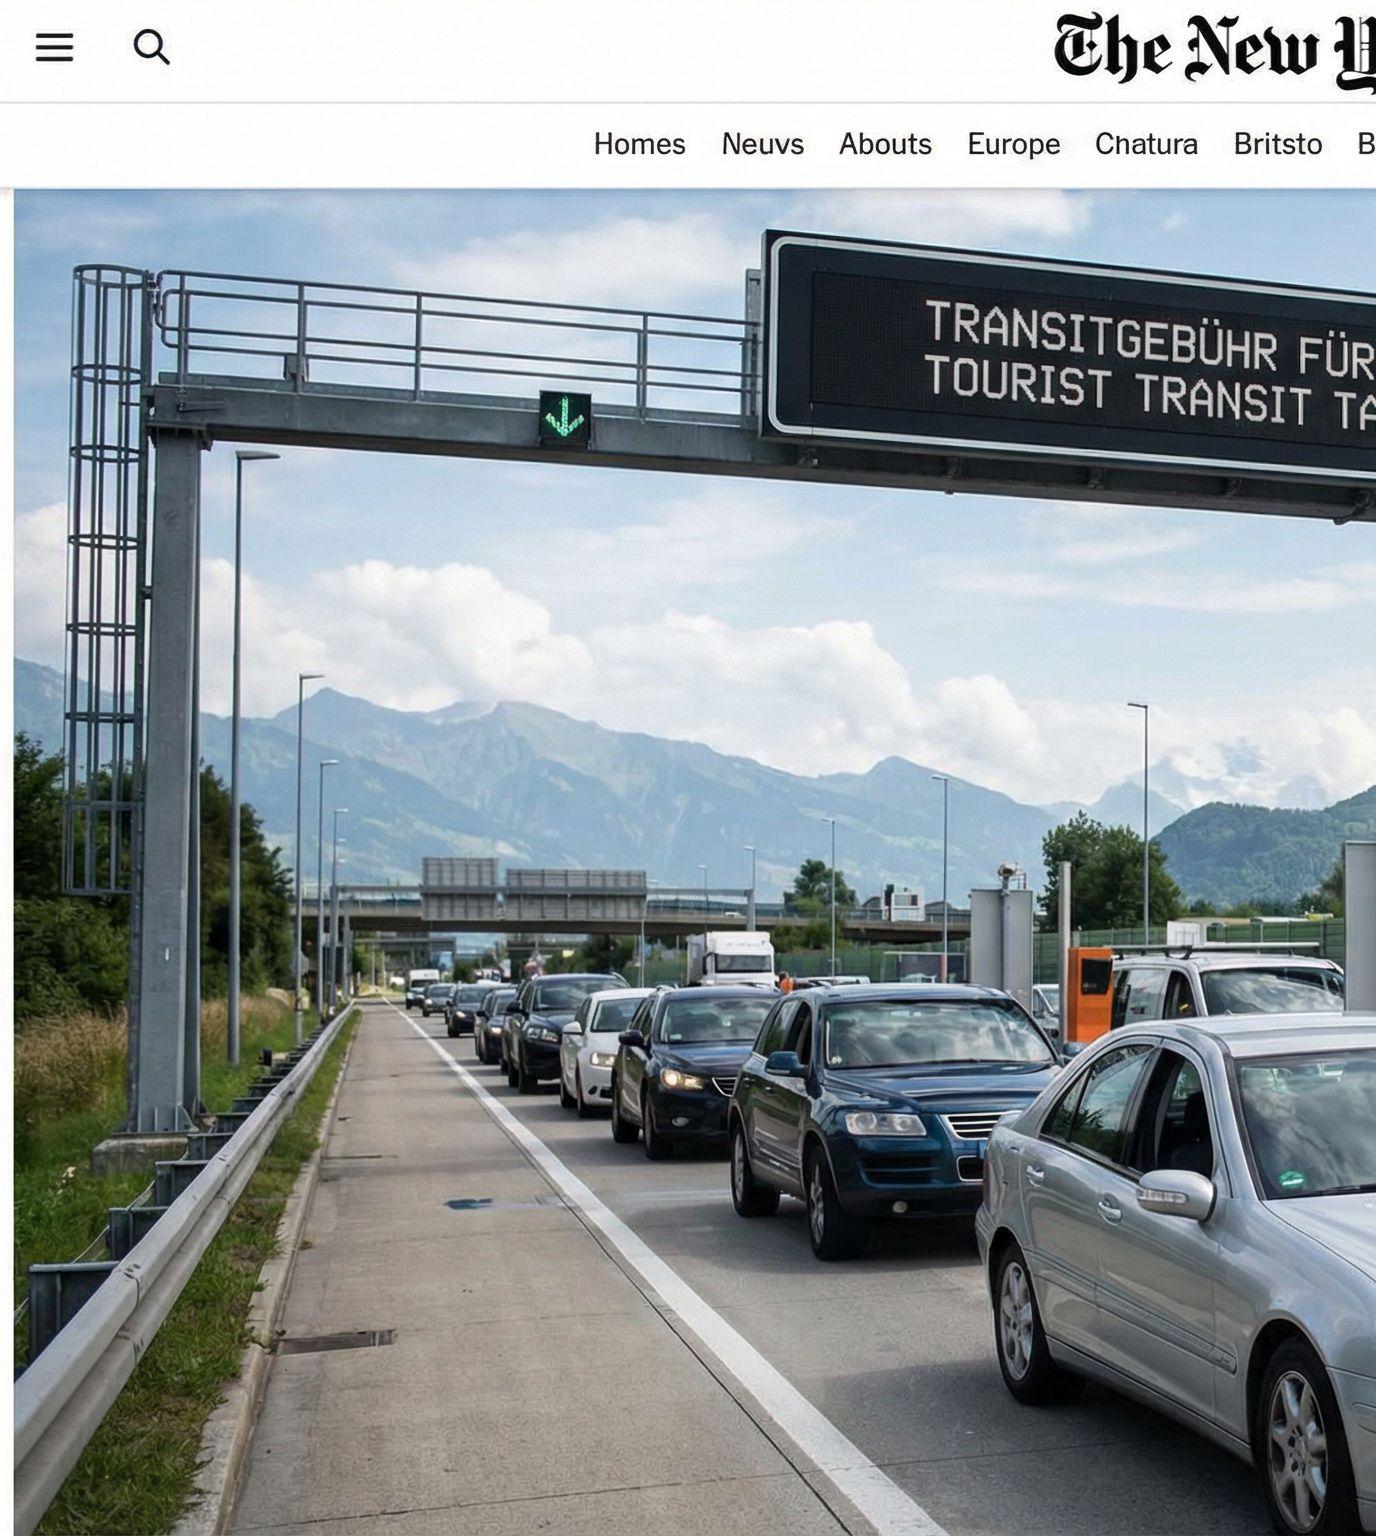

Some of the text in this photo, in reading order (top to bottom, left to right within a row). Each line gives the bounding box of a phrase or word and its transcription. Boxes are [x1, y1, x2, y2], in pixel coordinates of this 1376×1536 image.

[926, 299, 1277, 372] TRANSITGEBÜHR
[1299, 330, 1375, 381] FÜR
[924, 354, 1112, 409] TOURIST
[1135, 373, 1312, 426] TRANSIT
